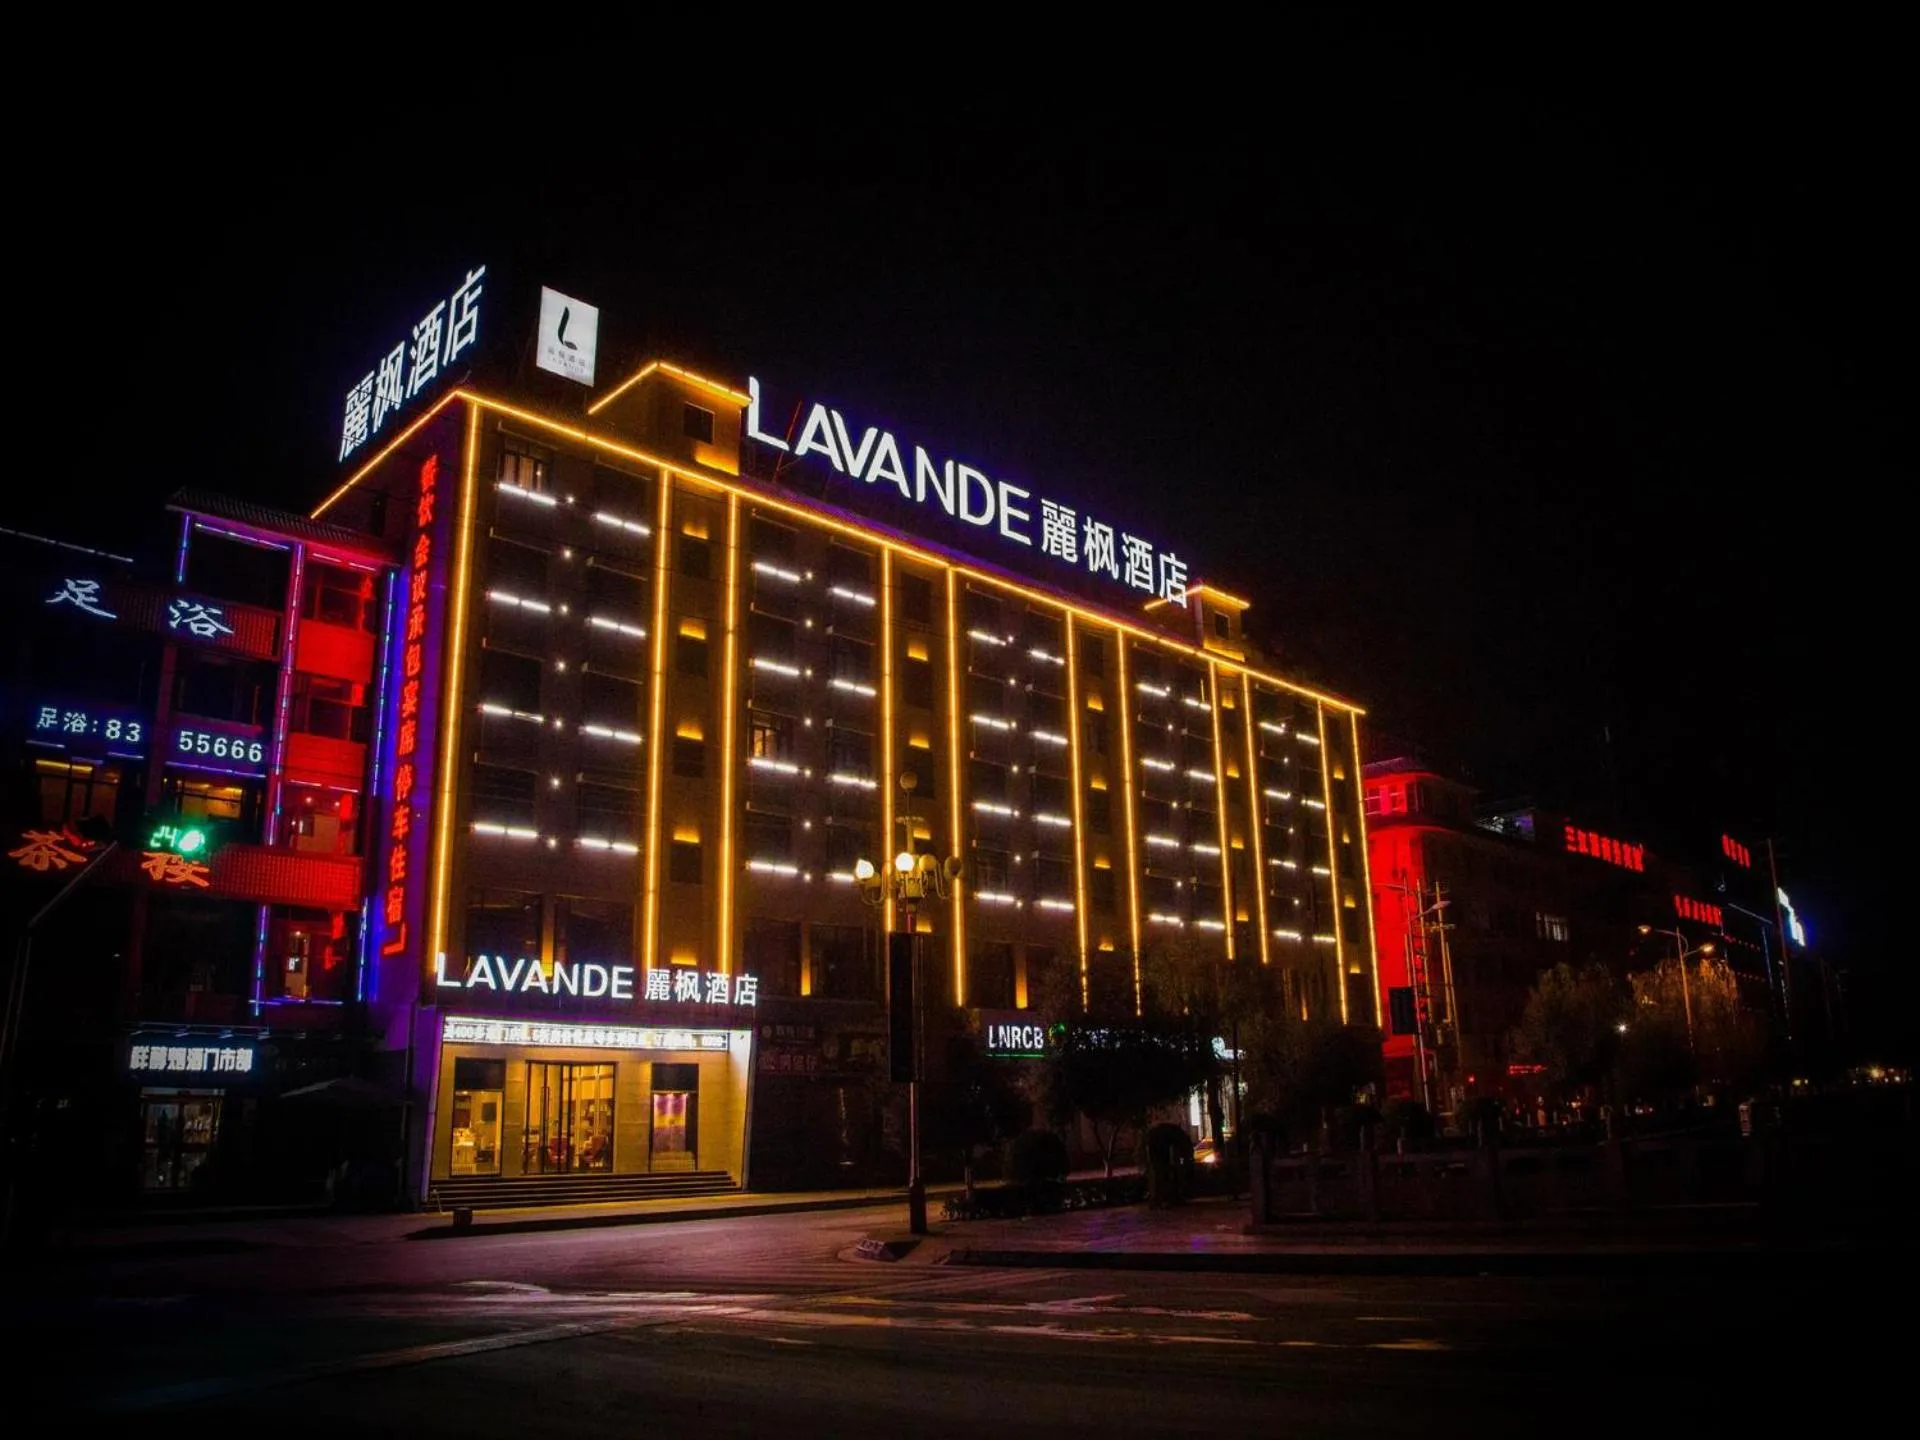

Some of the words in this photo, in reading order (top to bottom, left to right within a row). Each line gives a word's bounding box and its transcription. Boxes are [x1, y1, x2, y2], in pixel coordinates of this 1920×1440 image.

[748, 376, 1032, 546] LAVANDE
[1041, 497, 1188, 608] 麗枫酒店
[45, 578, 235, 638] 足浴
[179, 730, 262, 763] 55666
[435, 951, 634, 1000] LAVANDE
[644, 966, 758, 1007] 麗枫酒店
[988, 1024, 1044, 1050] LNRCB
